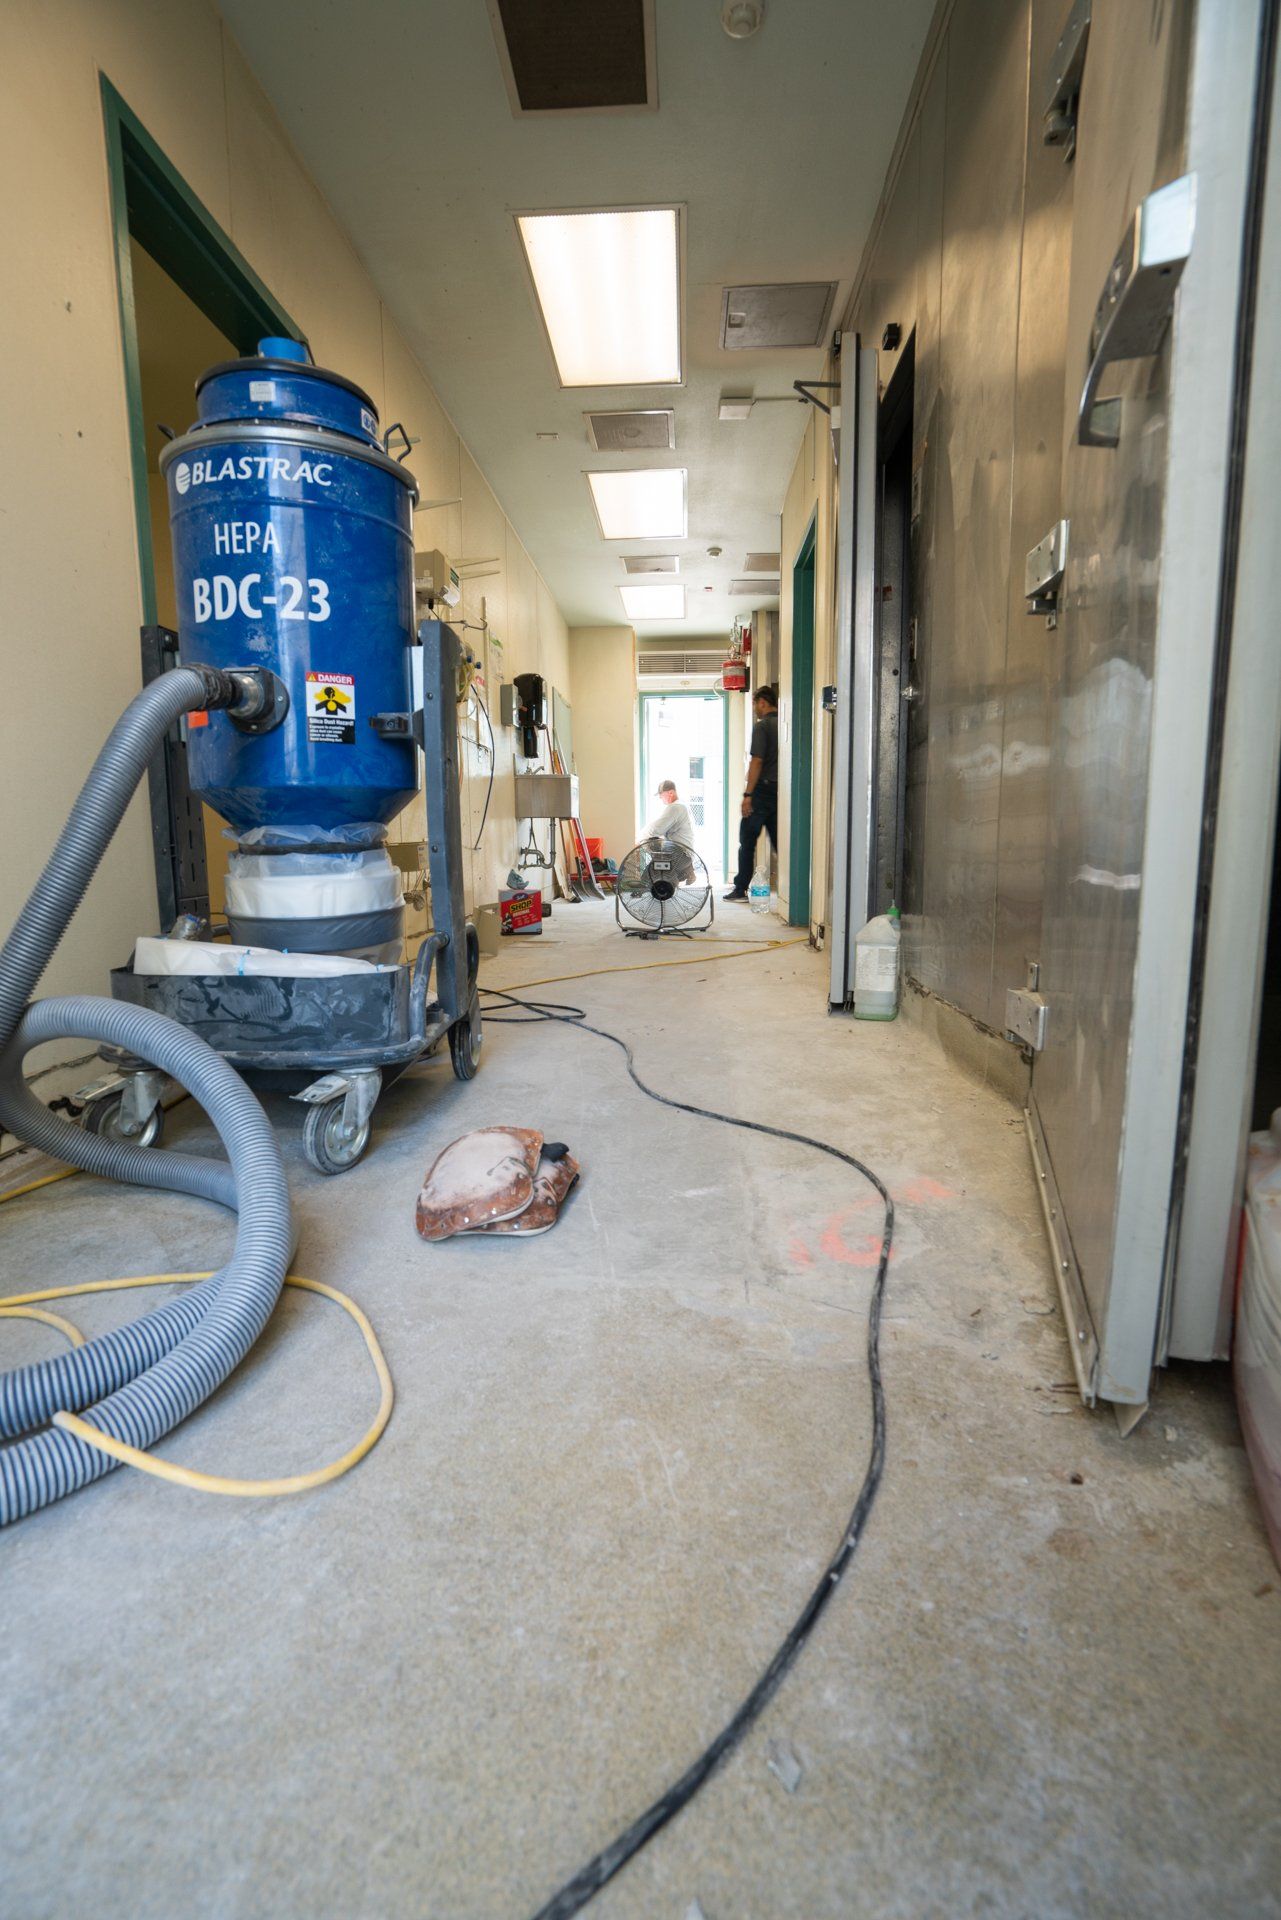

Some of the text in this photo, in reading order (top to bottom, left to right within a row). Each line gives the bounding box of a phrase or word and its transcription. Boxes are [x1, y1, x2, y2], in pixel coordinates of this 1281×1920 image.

[192, 456, 332, 487] BLASTRAC
[214, 521, 281, 556] HEPA
[193, 573, 332, 624] BDC-23
[318, 674, 352, 685] DANGER
[510, 900, 532, 911] SHOP
